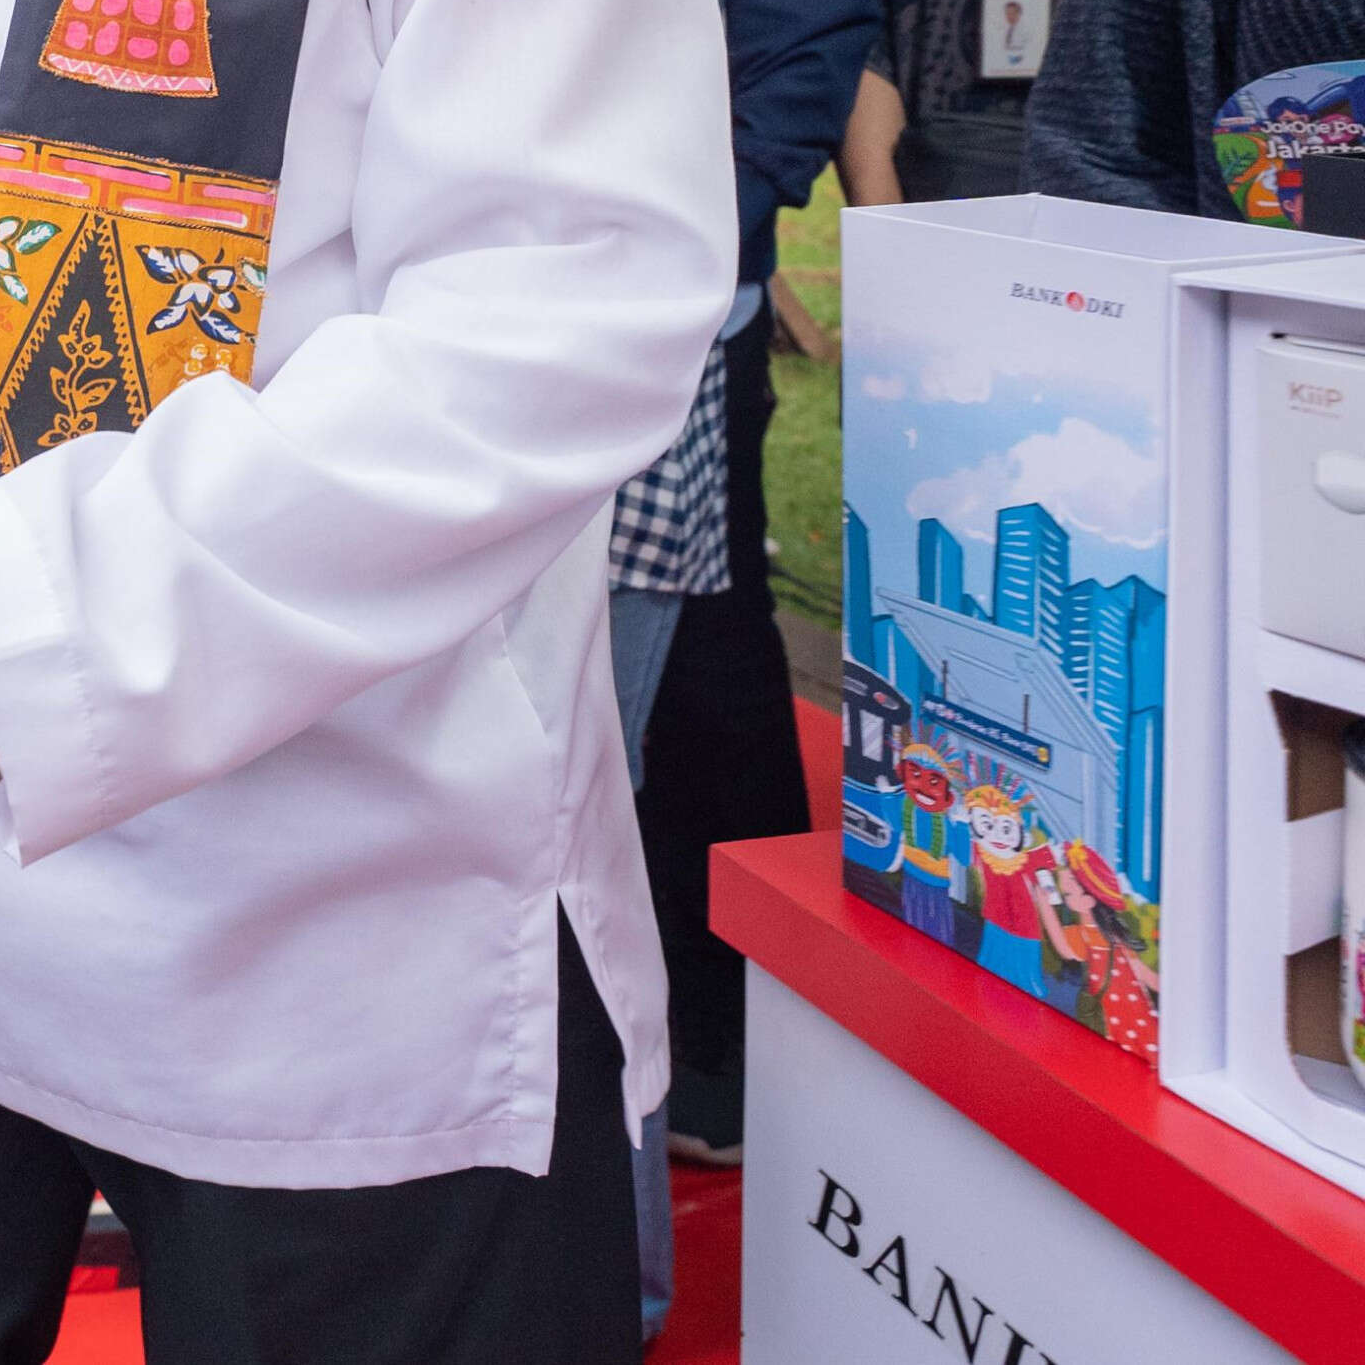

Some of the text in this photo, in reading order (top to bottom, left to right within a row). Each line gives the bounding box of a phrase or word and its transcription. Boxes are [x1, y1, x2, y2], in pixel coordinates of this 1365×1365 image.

[1010, 283, 1125, 318] BANK DKI
[807, 1168, 1057, 1365] BAN
